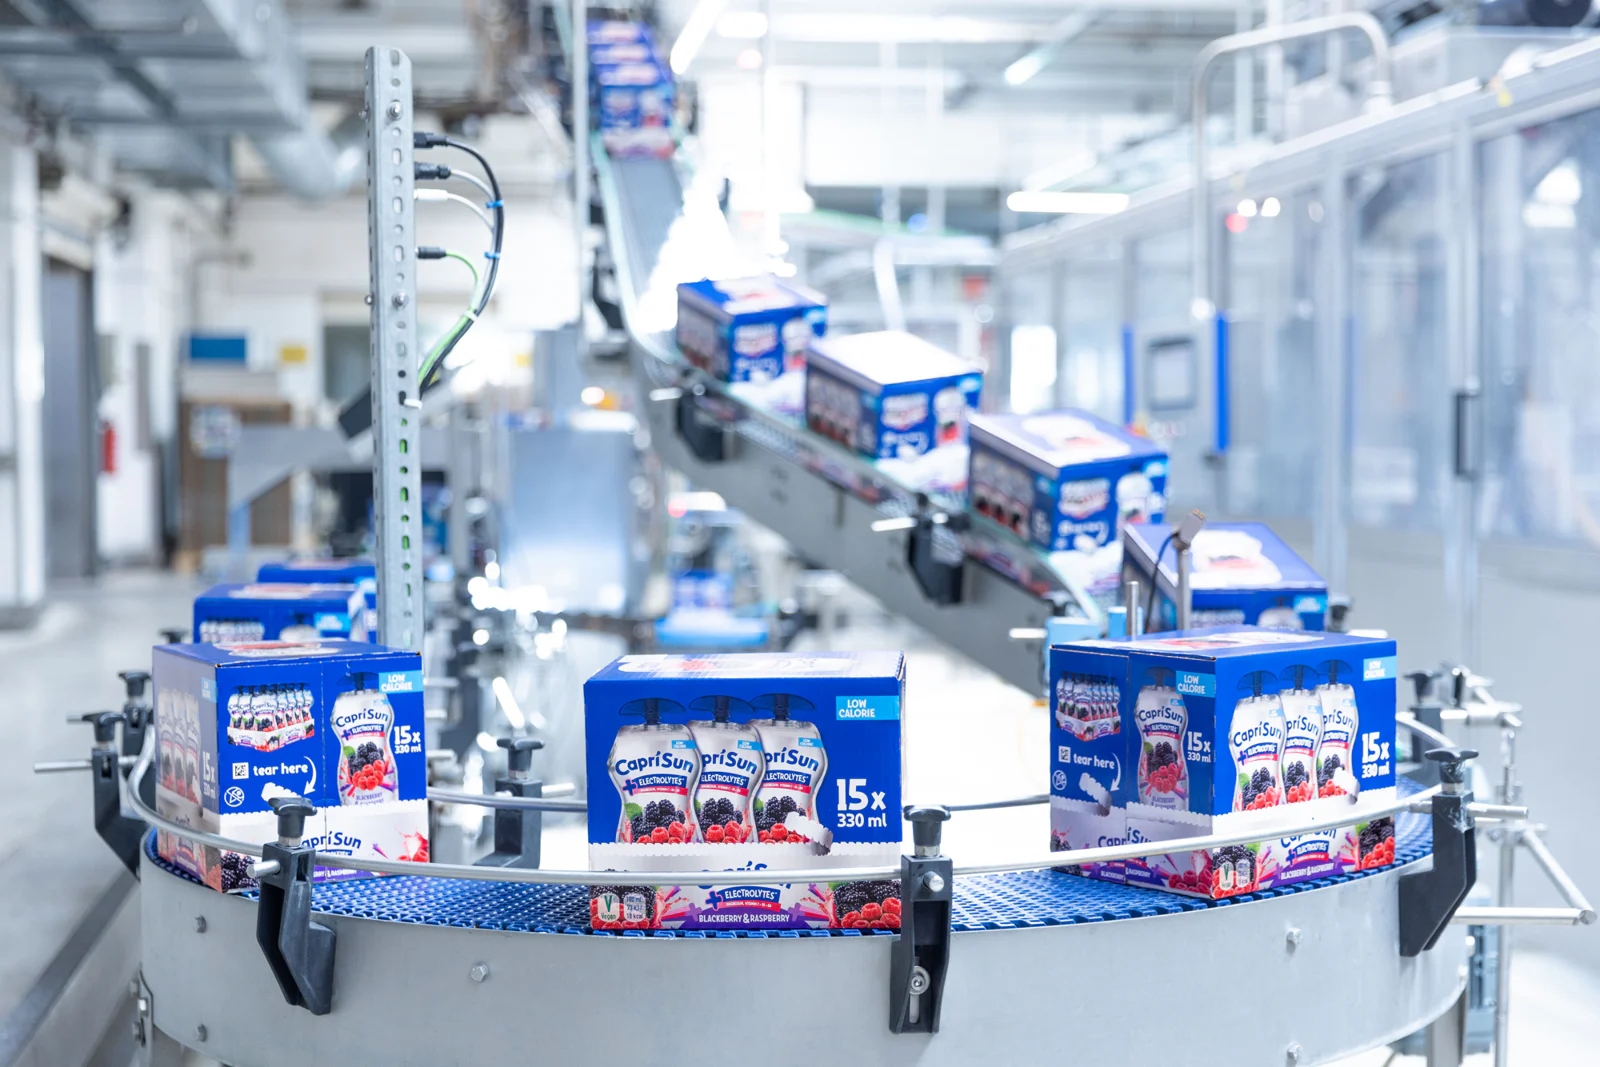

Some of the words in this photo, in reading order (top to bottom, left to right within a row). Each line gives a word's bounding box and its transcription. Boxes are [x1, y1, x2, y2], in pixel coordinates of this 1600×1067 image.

[388, 674, 405, 682] LOW
[1184, 675, 1200, 684] LOW
[1178, 683, 1206, 694] CALORIE
[847, 699, 867, 708] LOW
[838, 708, 876, 718] CALORIE
[394, 725, 421, 745] 15x
[1187, 731, 1211, 753] 15x
[1362, 731, 1390, 763] 15x
[394, 745, 410, 754] 330
[411, 744, 421, 753] ml
[1073, 753, 1092, 766] tear
[1094, 755, 1115, 769] here
[1187, 751, 1200, 761] 330
[1202, 754, 1211, 763] ml
[253, 766, 278, 777] tear
[281, 762, 308, 775] here
[837, 779, 886, 811] 15x
[837, 813, 864, 827] 330
[868, 813, 887, 827] ml
[699, 914, 742, 923] BLACKBERRY
[743, 913, 750, 924] &
[750, 914, 790, 923] RASPBERRY
